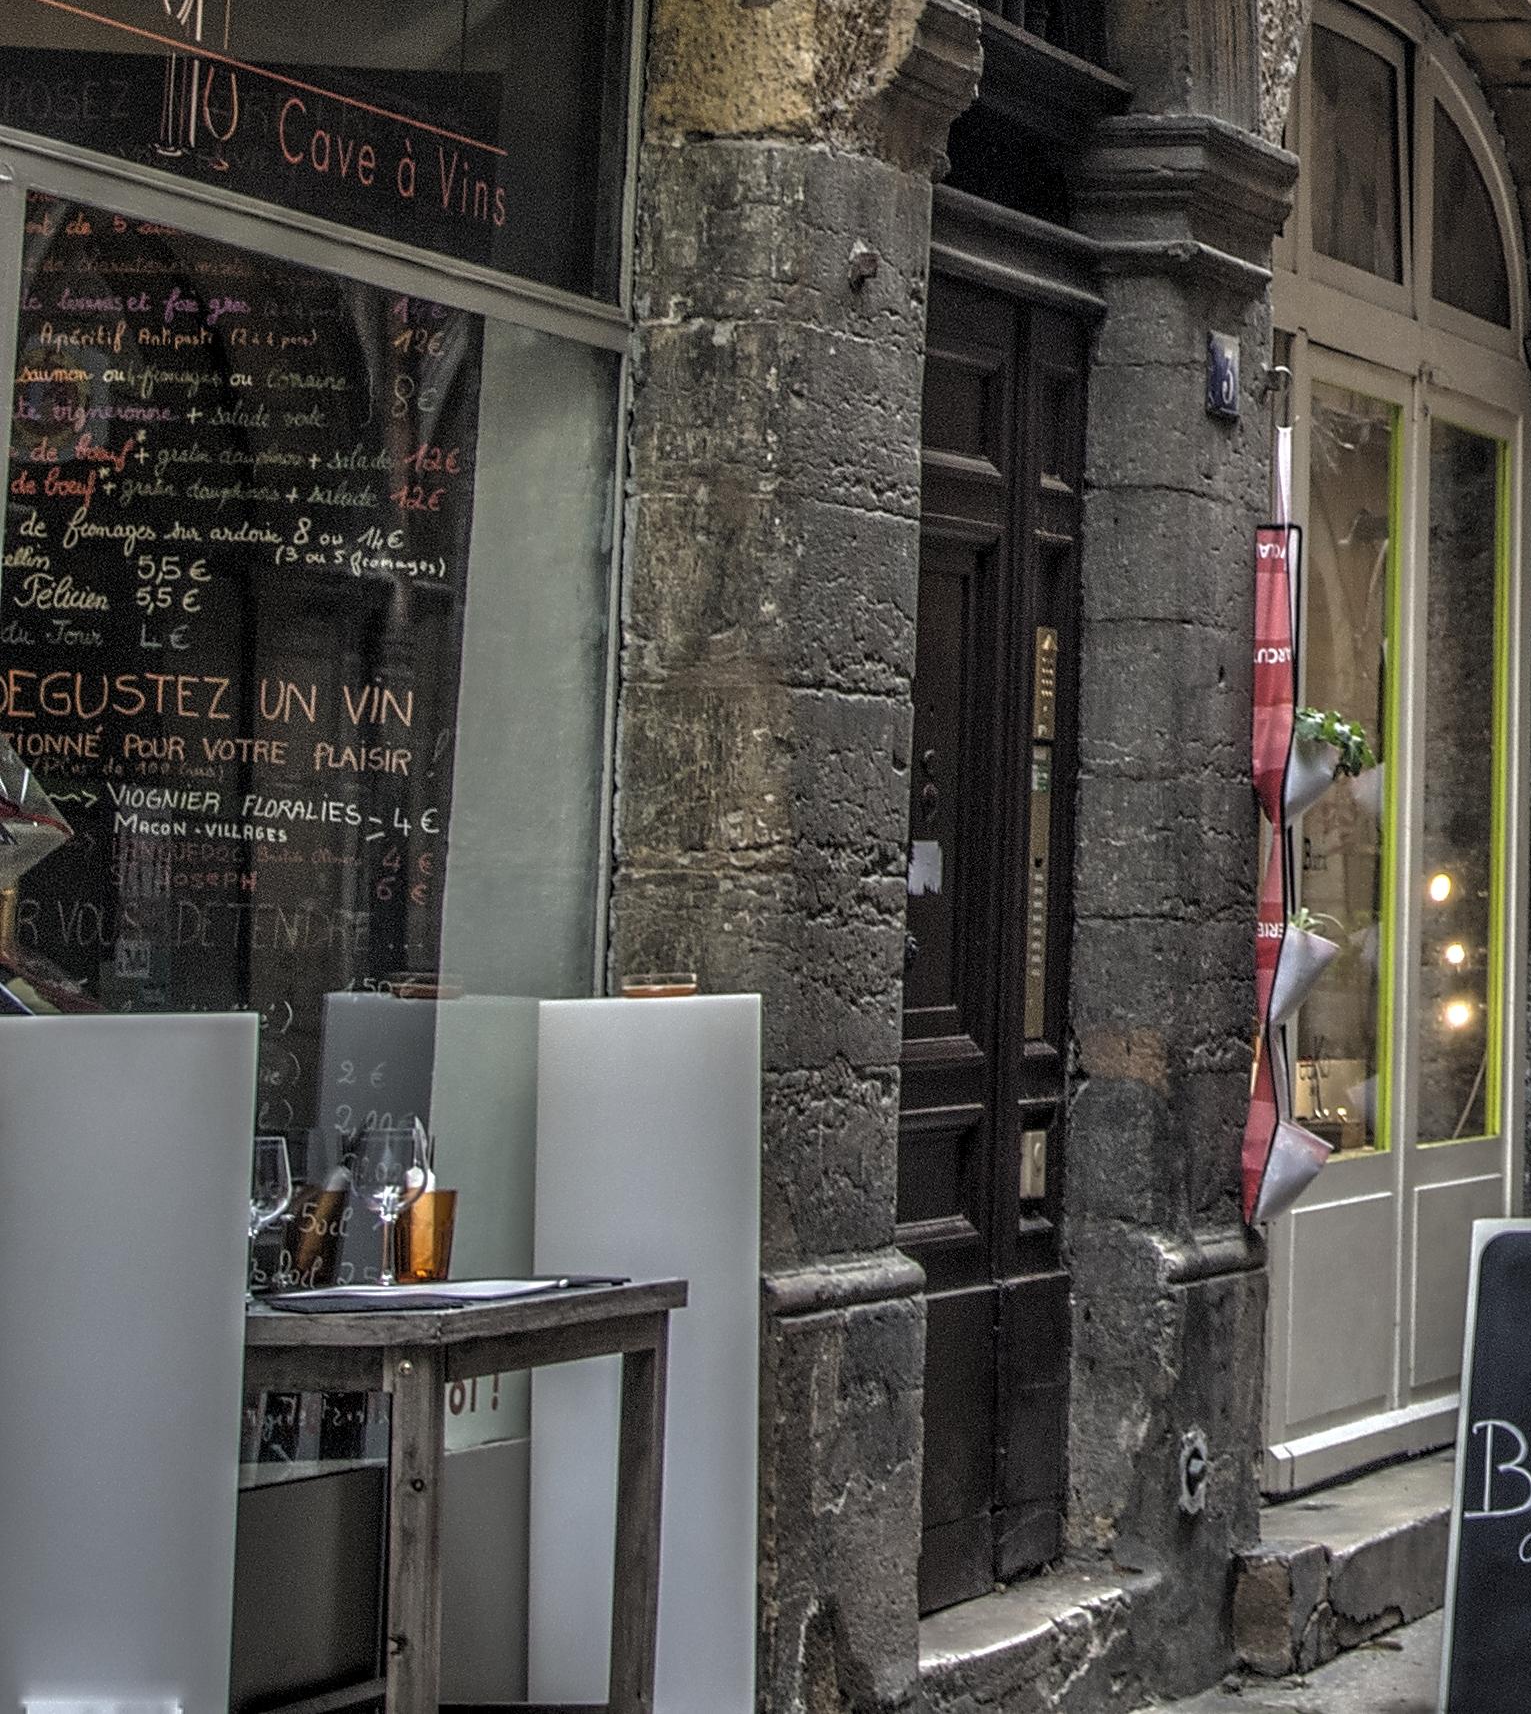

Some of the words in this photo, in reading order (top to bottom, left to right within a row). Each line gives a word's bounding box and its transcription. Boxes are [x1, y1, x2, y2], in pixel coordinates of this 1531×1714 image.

[280, 97, 377, 186] Cave
[396, 138, 418, 199] à
[439, 147, 508, 227] Vins
[39, 319, 128, 354] Apéritif
[16, 367, 95, 383] saumon
[230, 372, 253, 387] ou
[20, 510, 48, 538] de
[63, 505, 156, 557] fromages
[293, 517, 312, 545] 8
[319, 532, 344, 547] ou
[189, 559, 212, 582] €
[183, 588, 202, 613] €
[260, 677, 317, 724] UN
[124, 734, 186, 762] POUR
[203, 737, 289, 765] VOTRE
[204, 822, 288, 844] VILLAGES
